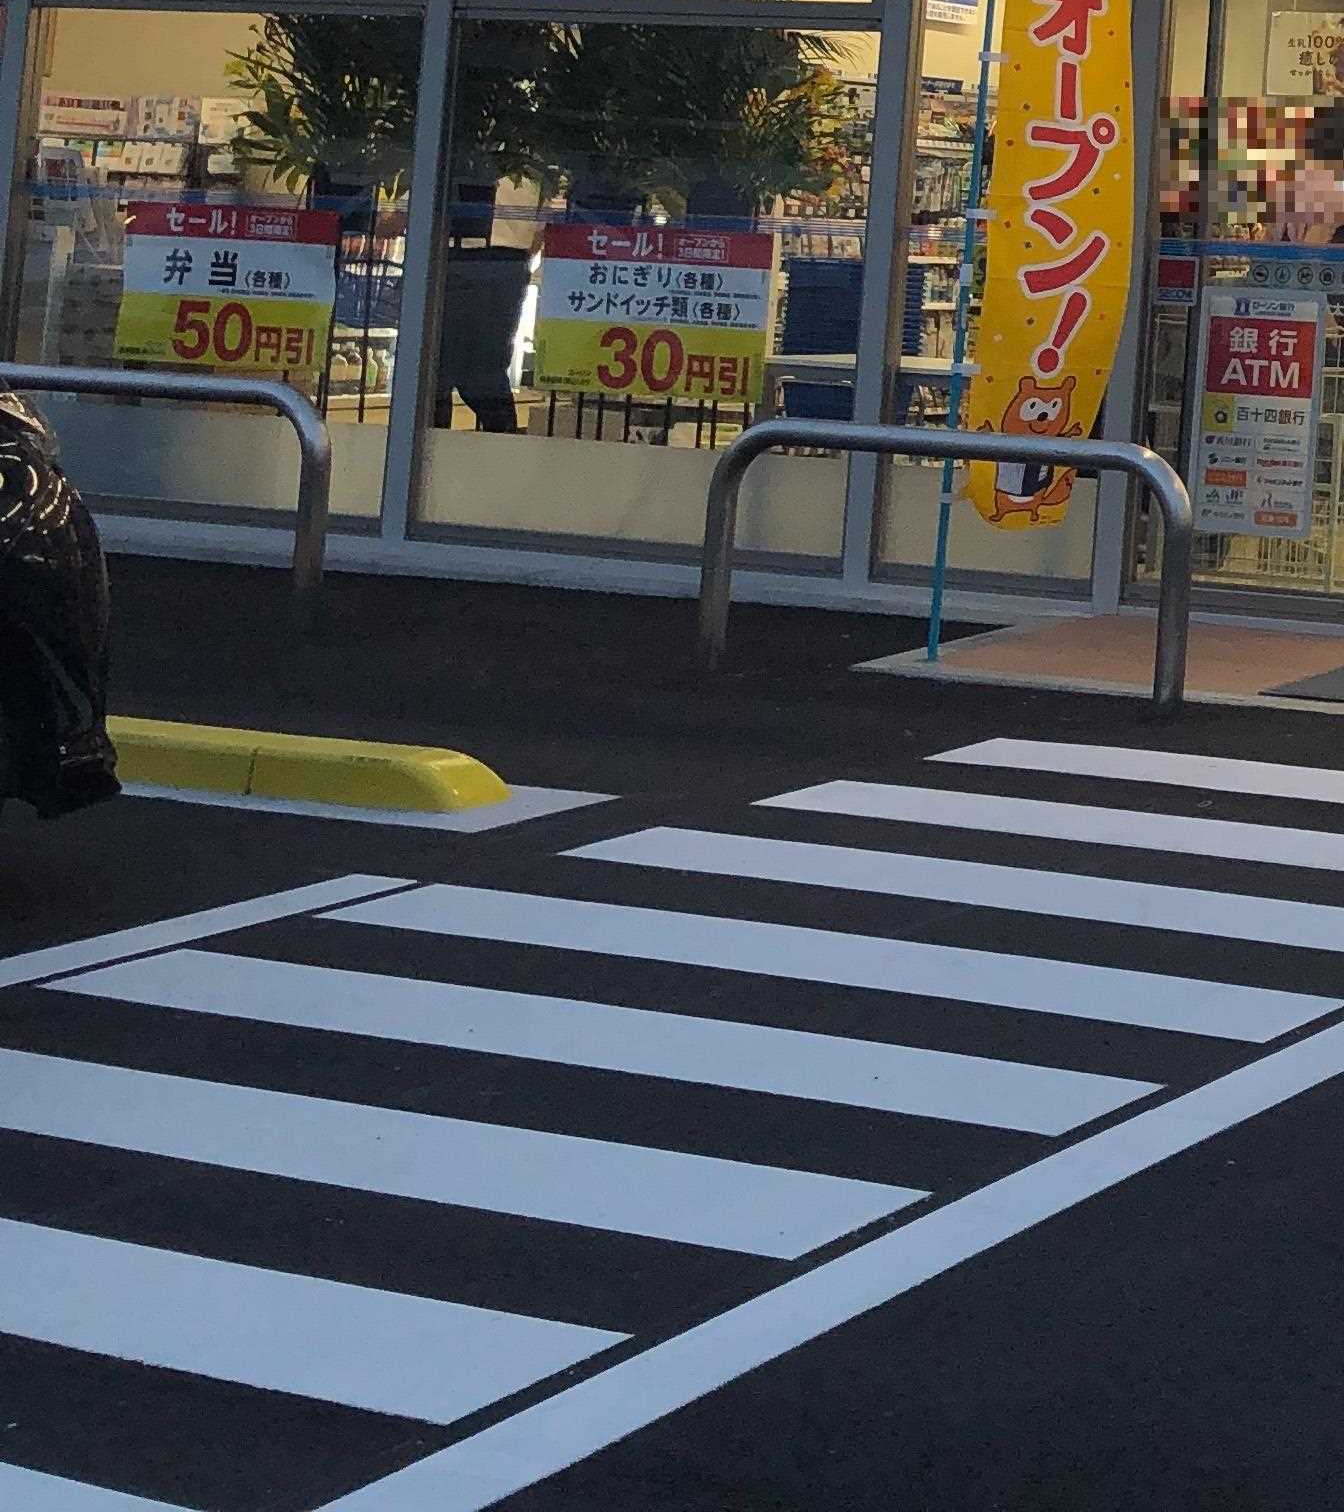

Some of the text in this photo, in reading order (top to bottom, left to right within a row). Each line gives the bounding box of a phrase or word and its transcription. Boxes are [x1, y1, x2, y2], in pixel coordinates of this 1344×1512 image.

[166, 206, 238, 236] セール!
[587, 229, 664, 259] セール!
[172, 299, 315, 365] 50円引
[1229, 326, 1298, 357] 銀行
[596, 326, 750, 396] 30円引
[1219, 357, 1300, 389] ATM
[1236, 406, 1306, 426] 百十四銀行
